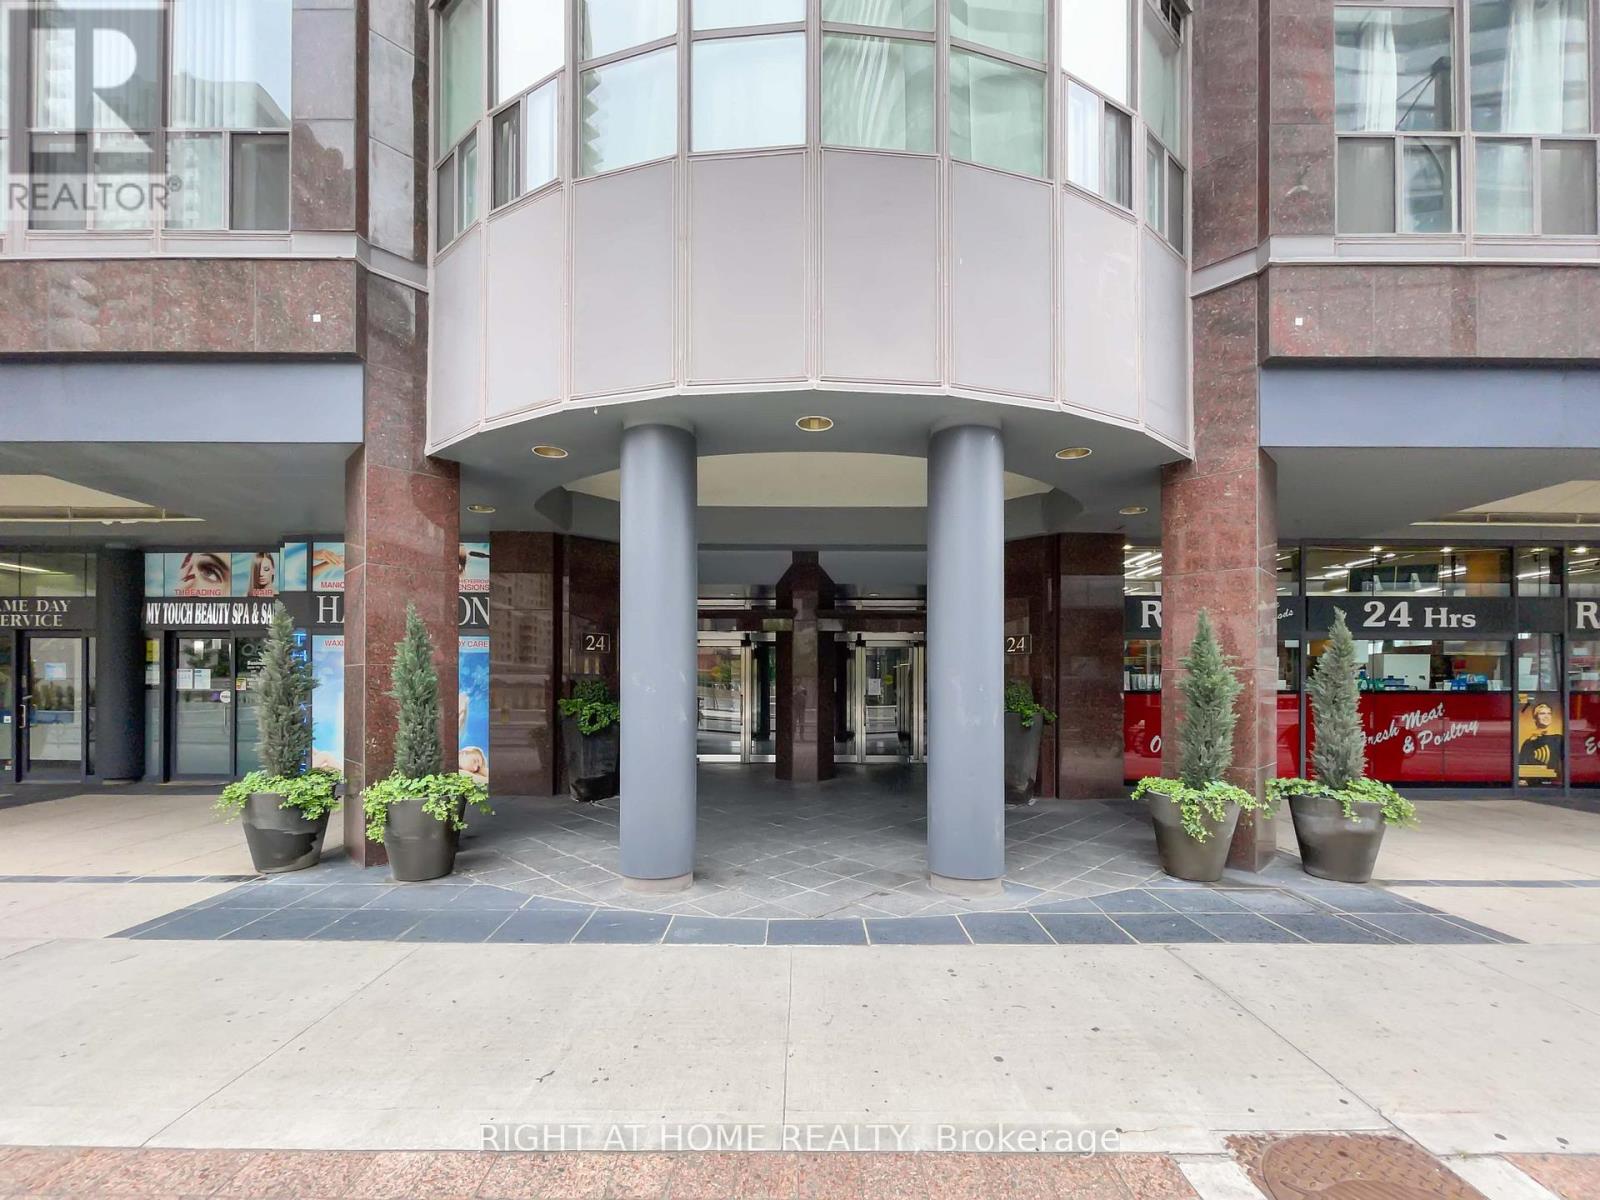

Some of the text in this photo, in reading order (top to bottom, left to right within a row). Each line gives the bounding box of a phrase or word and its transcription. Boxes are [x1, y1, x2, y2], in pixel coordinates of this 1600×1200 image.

[37, 600, 70, 613] DAY
[146, 602, 161, 625] MY
[163, 602, 194, 625] TOUCH
[195, 602, 231, 625] BEAUTY
[231, 602, 250, 625] SPA
[251, 602, 260, 625] &
[316, 596, 344, 624] H
[1363, 601, 1477, 628] 24 Hrs
[468, 640, 488, 648] CARE
[586, 635, 606, 651] 24
[1006, 636, 1026, 652] 24
[1402, 702, 1445, 730] Meat
[1402, 720, 1480, 754] & Poultry
